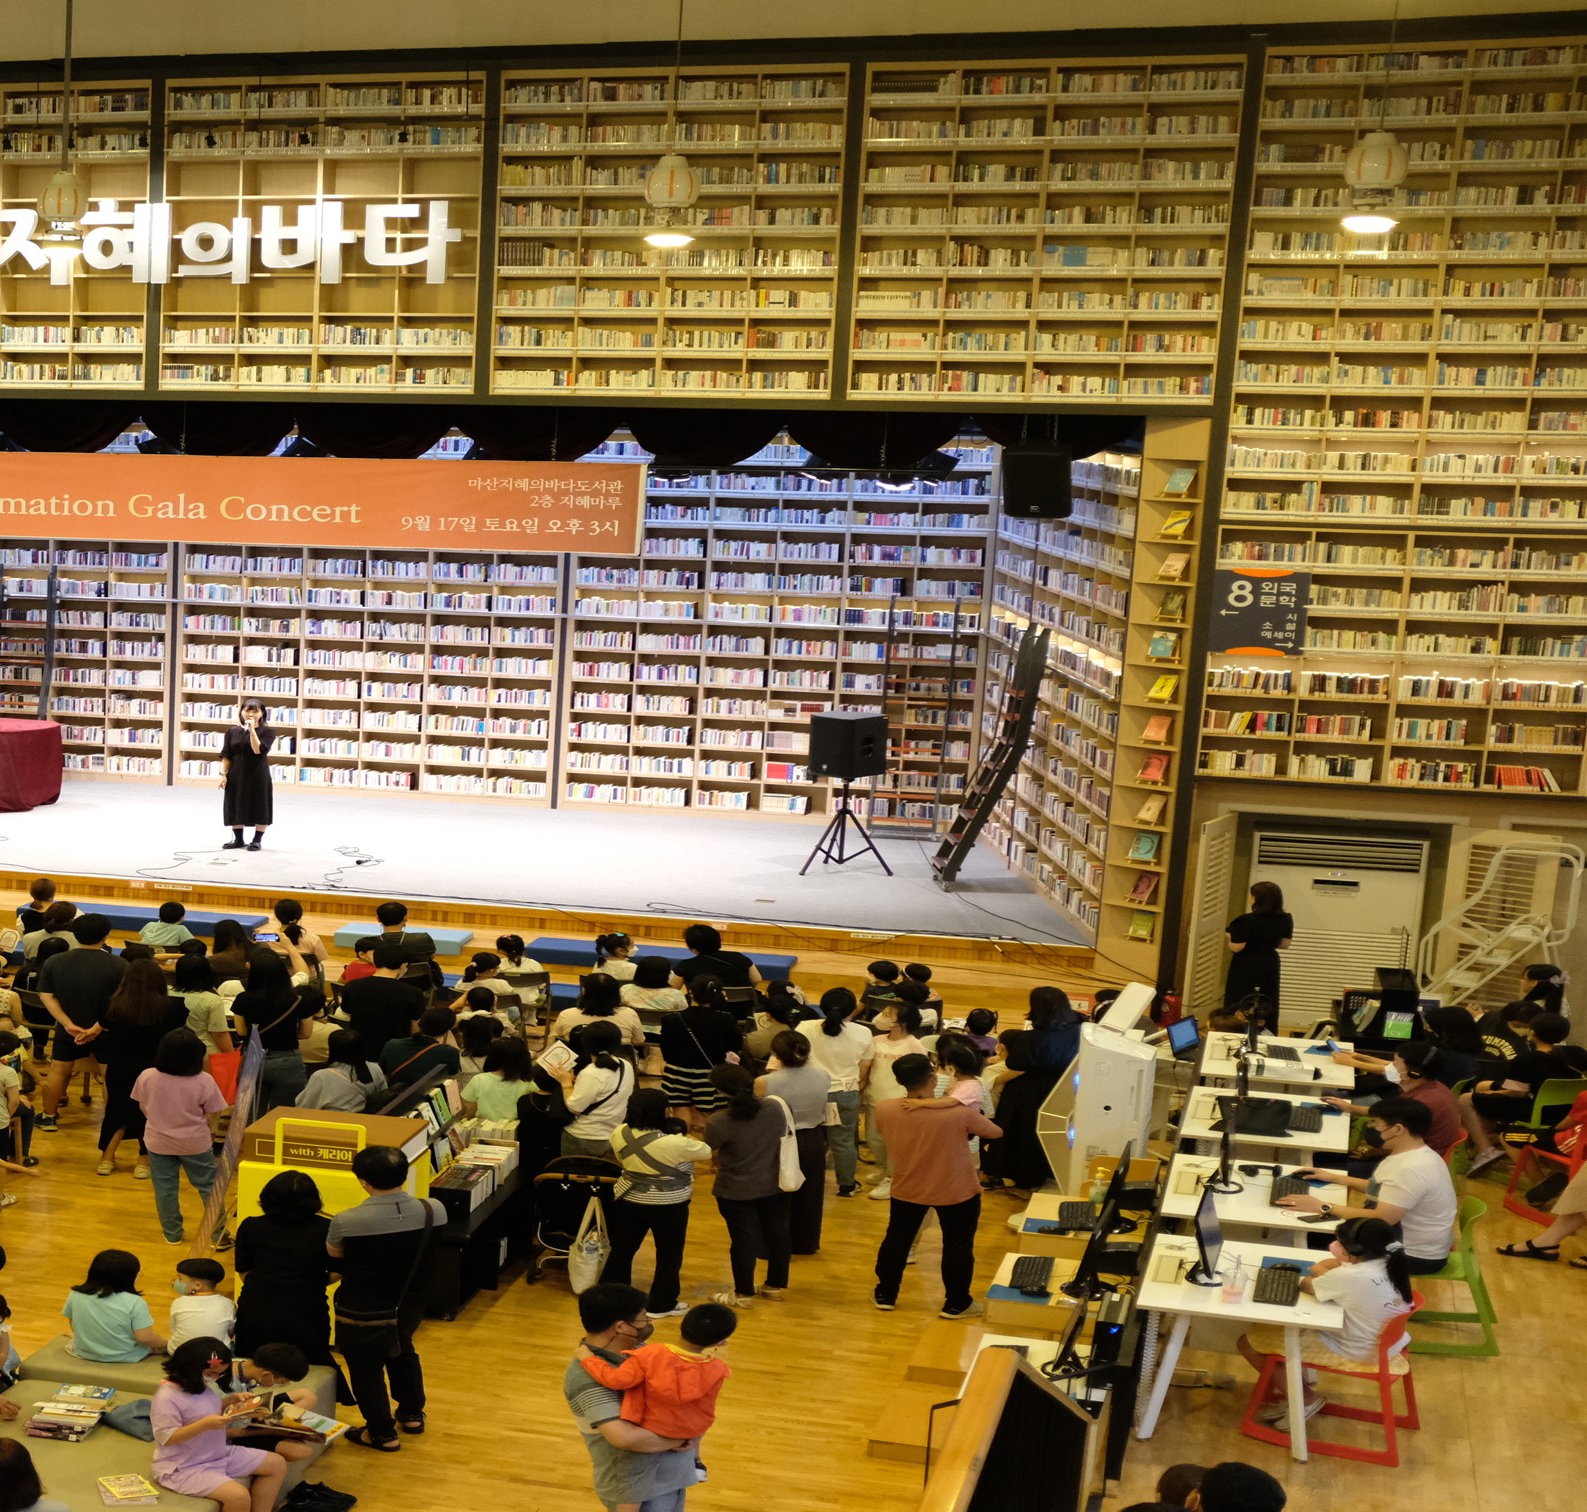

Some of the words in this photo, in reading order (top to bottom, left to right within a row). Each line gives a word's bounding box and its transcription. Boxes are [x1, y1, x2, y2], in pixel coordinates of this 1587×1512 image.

[467, 477, 624, 494] 마산지혜의바다도서관
[128, 492, 208, 520] Gala
[219, 495, 362, 524] Concert
[529, 494, 556, 509] 2층
[560, 495, 623, 510] 지혜마루
[401, 515, 431, 532] 9월
[438, 516, 477, 533] 17일
[482, 517, 539, 535] 토요일
[545, 518, 585, 536] 오후
[588, 519, 620, 537] 3시
[1227, 580, 1254, 608] 8
[1260, 581, 1298, 595] 외국
[1260, 595, 1298, 609] 문학
[1286, 613, 1298, 622] 시
[1260, 630, 1297, 641] 에세이
[289, 1147, 315, 1157] with
[316, 1147, 353, 1162] 캐리어
